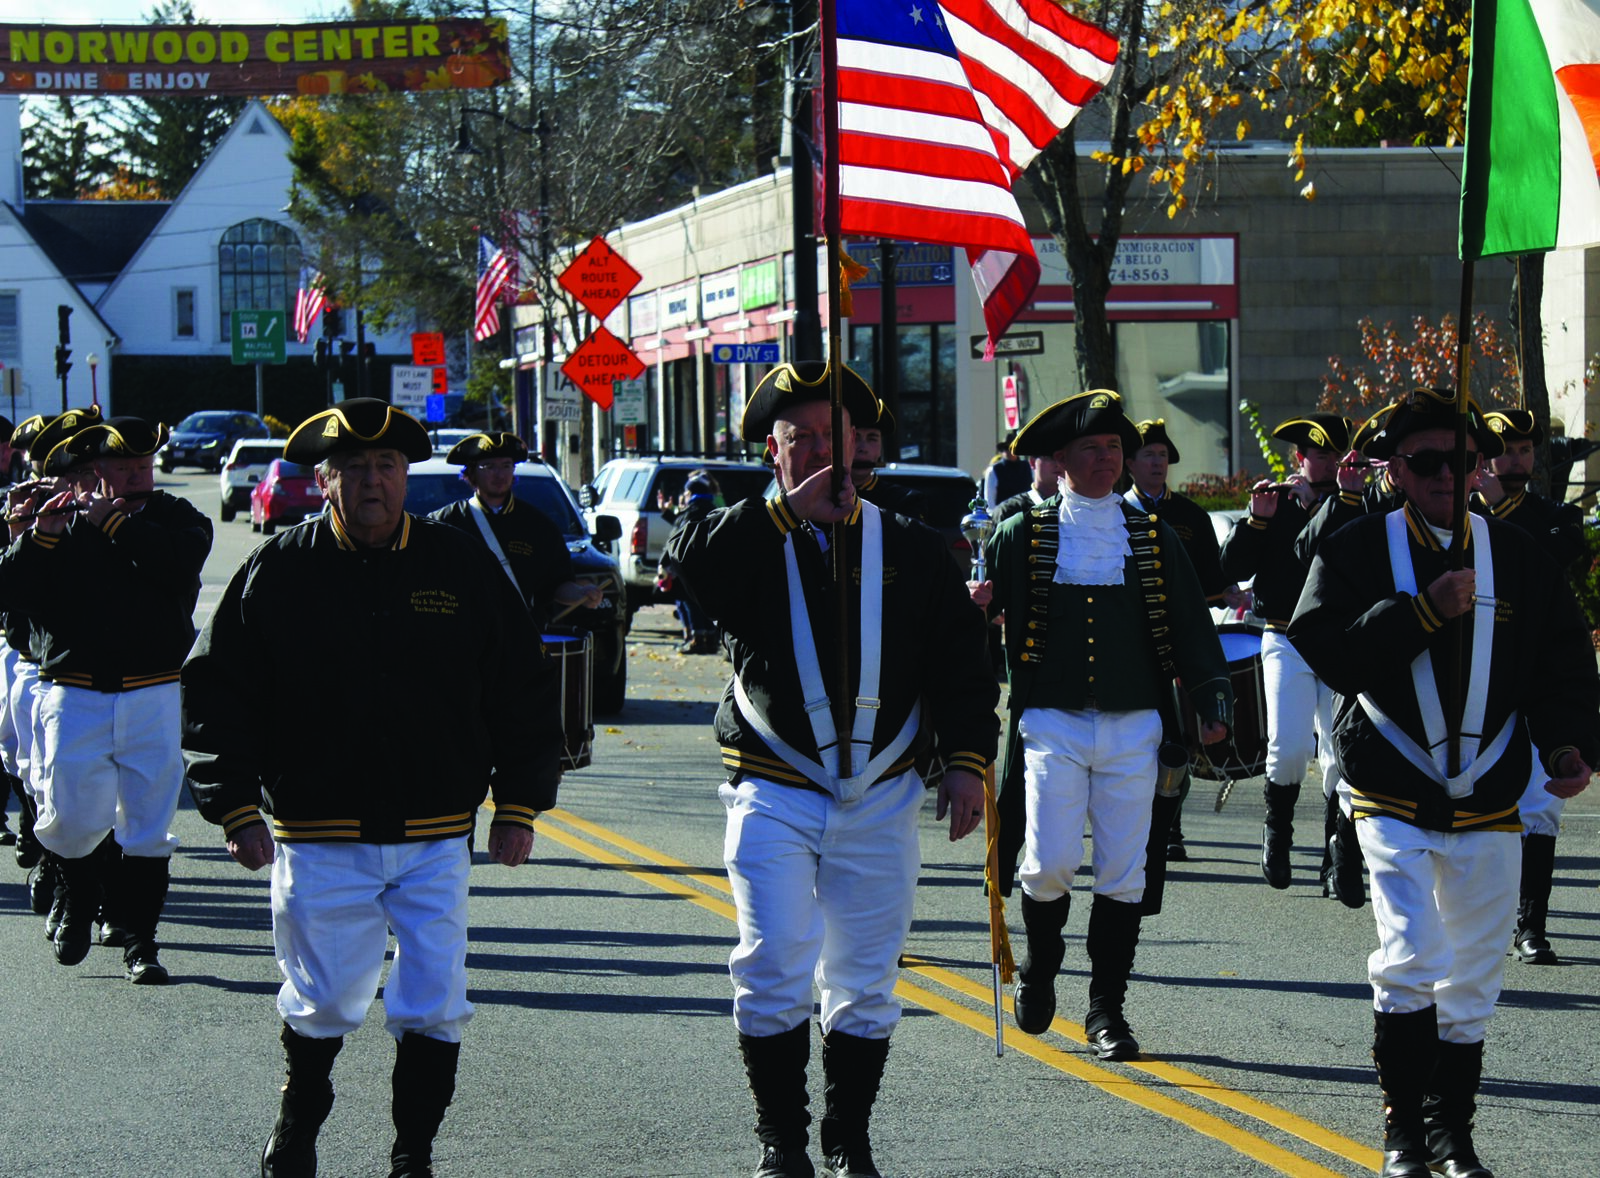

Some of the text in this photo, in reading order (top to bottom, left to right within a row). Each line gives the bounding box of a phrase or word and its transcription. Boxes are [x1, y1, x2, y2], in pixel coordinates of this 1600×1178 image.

[9, 25, 441, 64] NORWOOD CENTER
[35, 72, 98, 89] DINE
[128, 72, 211, 89] ENJOY
[1117, 241, 1196, 254] INMIGRACION
[588, 256, 609, 267] ALT
[1124, 254, 1163, 266] BELLO
[581, 272, 619, 283] ROUTE
[582, 288, 621, 299] AHEAD
[243, 325, 255, 336] 1A
[1016, 337, 1037, 349] WAY
[736, 346, 775, 361] DAY ST
[578, 353, 629, 368] DETOUR
[553, 370, 576, 393] 1A
[548, 404, 580, 417] SOUTH
